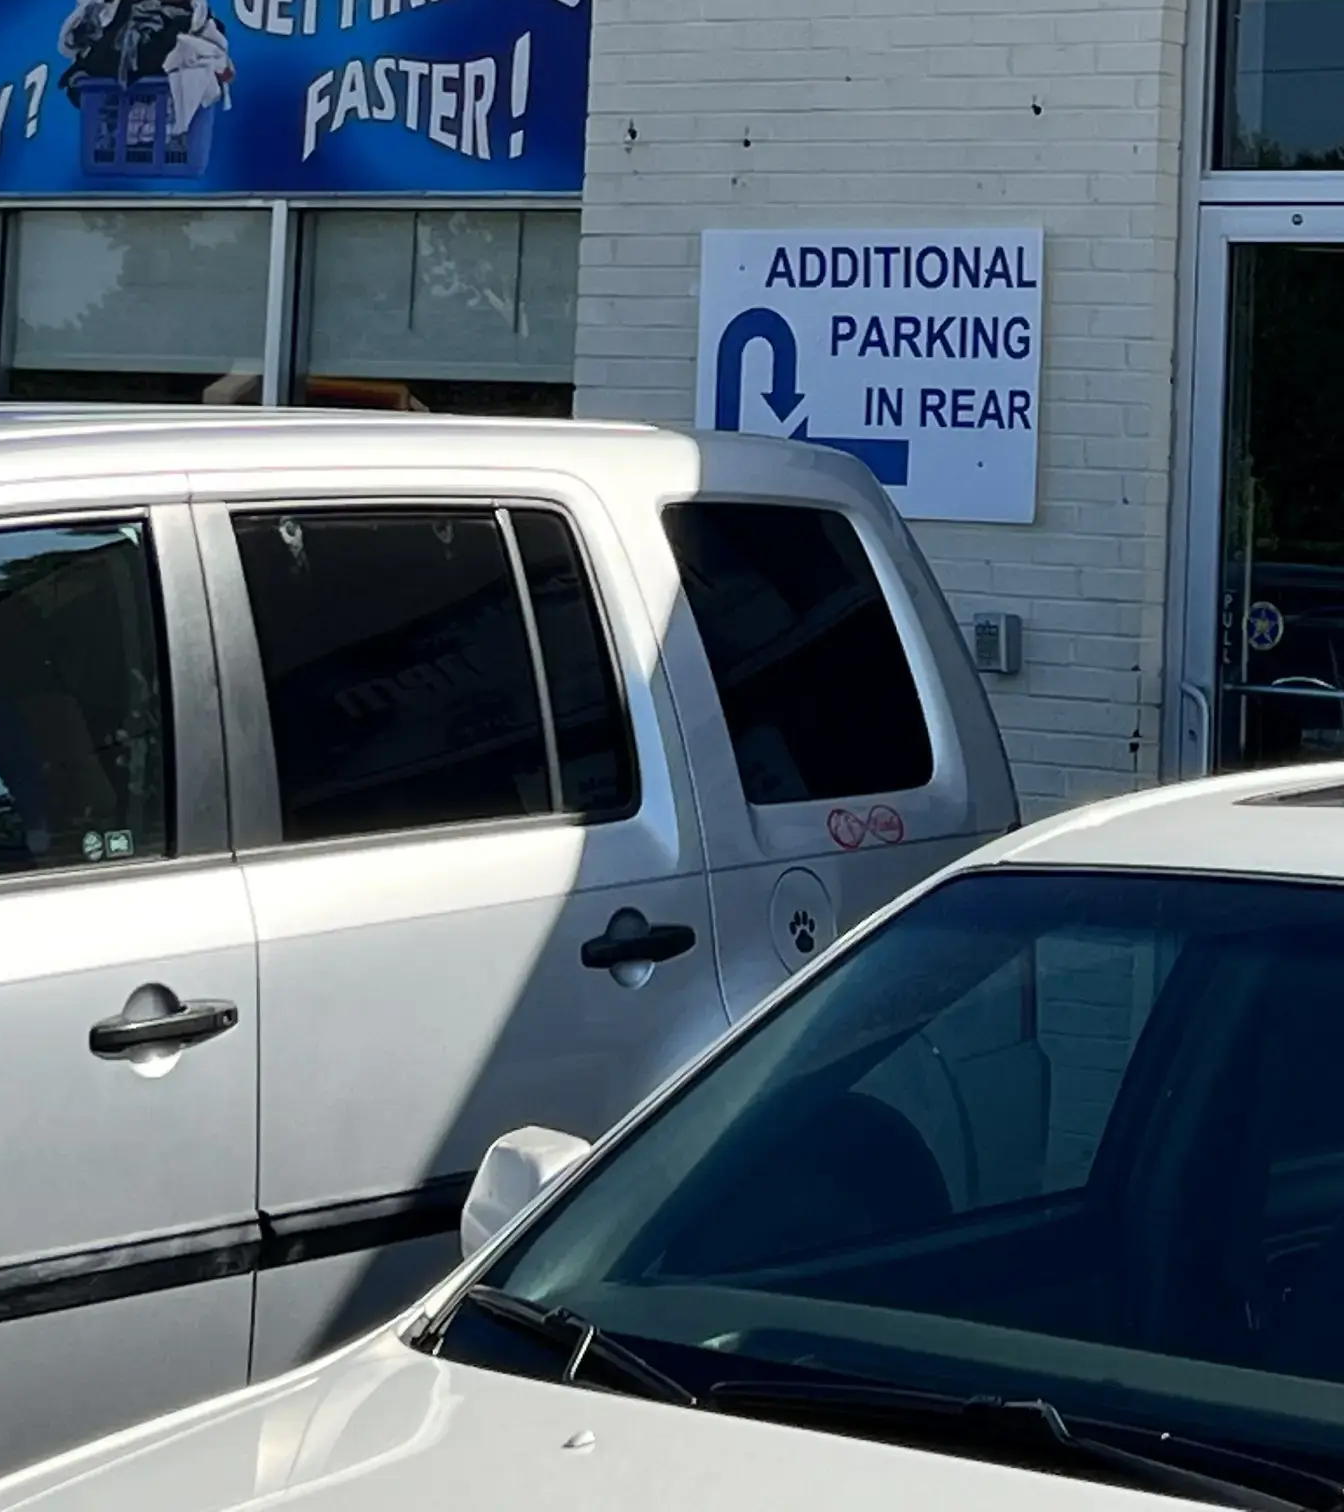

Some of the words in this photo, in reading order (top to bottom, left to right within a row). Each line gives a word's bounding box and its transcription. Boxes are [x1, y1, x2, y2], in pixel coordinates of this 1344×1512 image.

[765, 245, 1038, 290] ADDITIONAL
[830, 314, 1032, 361] PARKING
[863, 386, 904, 427] IN
[919, 387, 1033, 430] REAR
